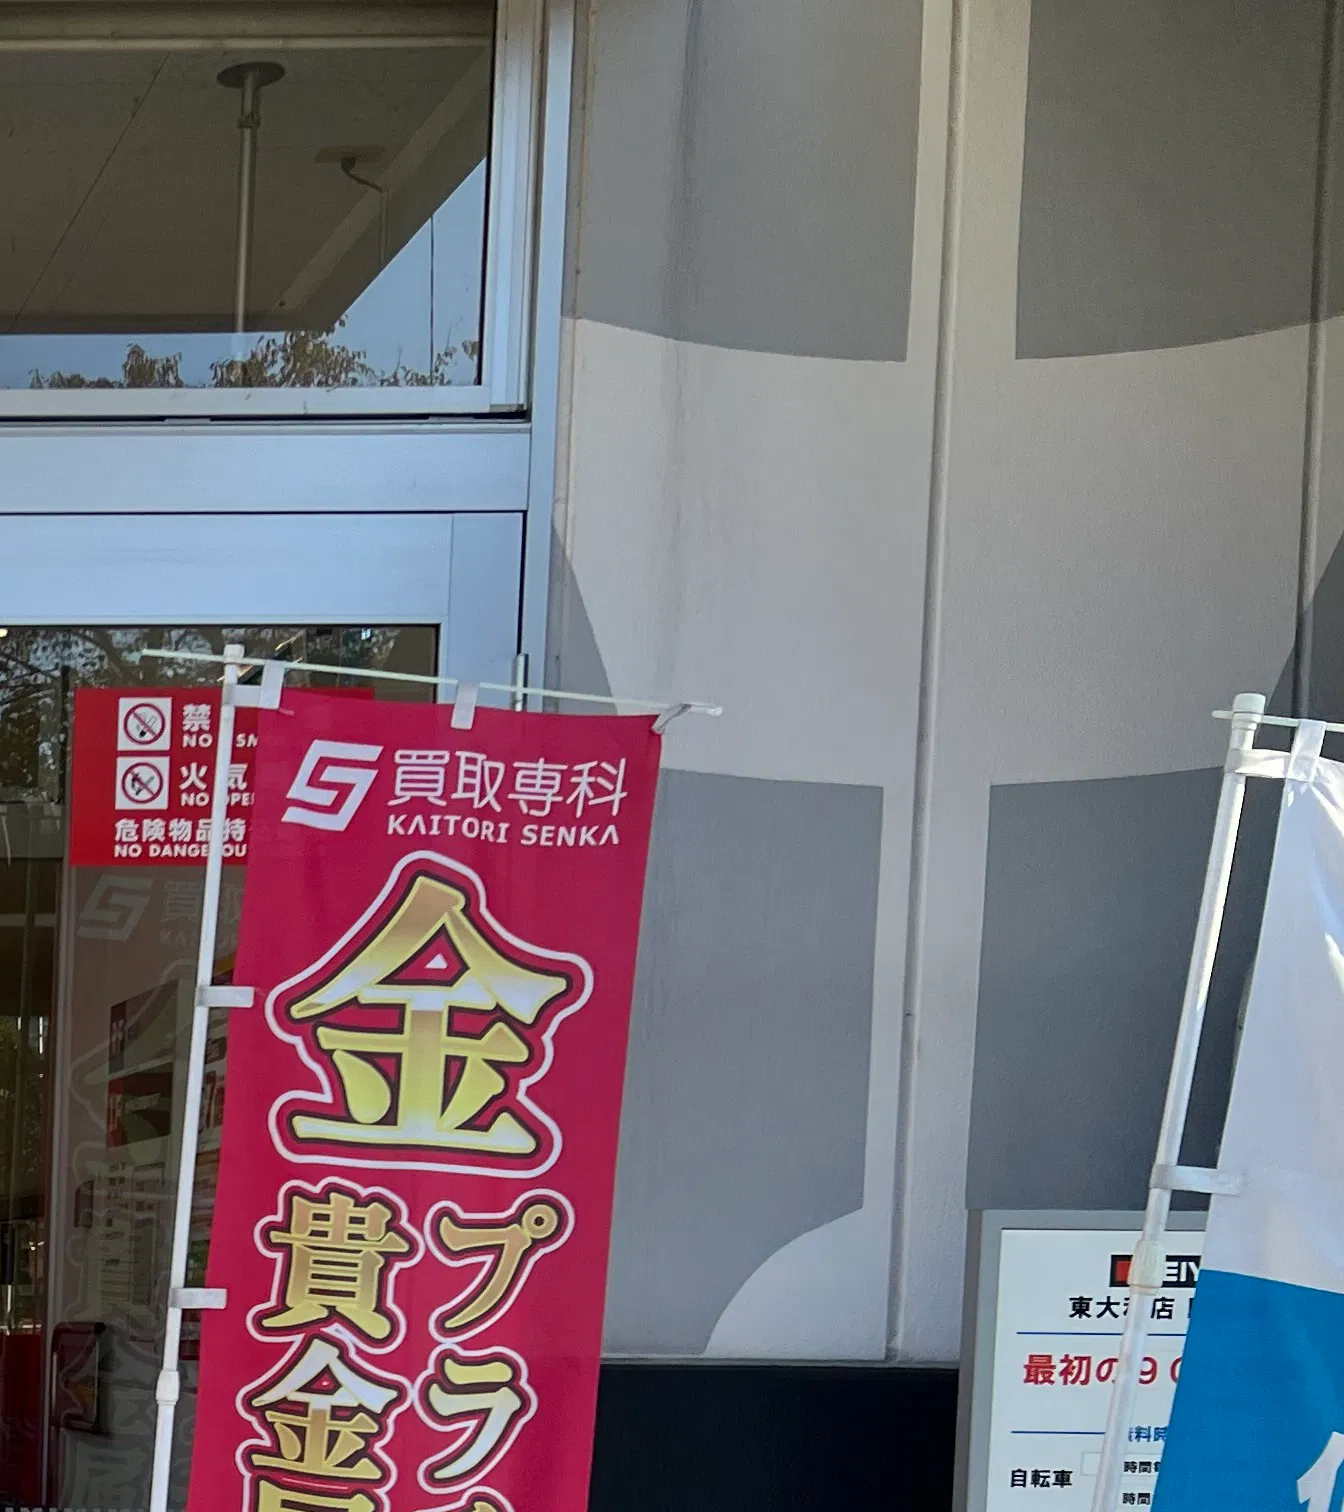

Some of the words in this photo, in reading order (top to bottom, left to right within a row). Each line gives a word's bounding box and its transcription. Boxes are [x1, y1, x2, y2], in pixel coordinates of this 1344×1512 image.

[182, 733, 213, 748] NO
[387, 749, 629, 819] 買取専科
[180, 792, 210, 807] NO
[387, 814, 510, 843] KAITORI
[520, 825, 620, 847] SENKA
[114, 844, 142, 858] NO
[149, 844, 248, 858] DANGEOU
[284, 868, 576, 1162] 金
[1165, 1261, 1199, 1282] EIY
[1011, 1468, 1073, 1488] 自転車
